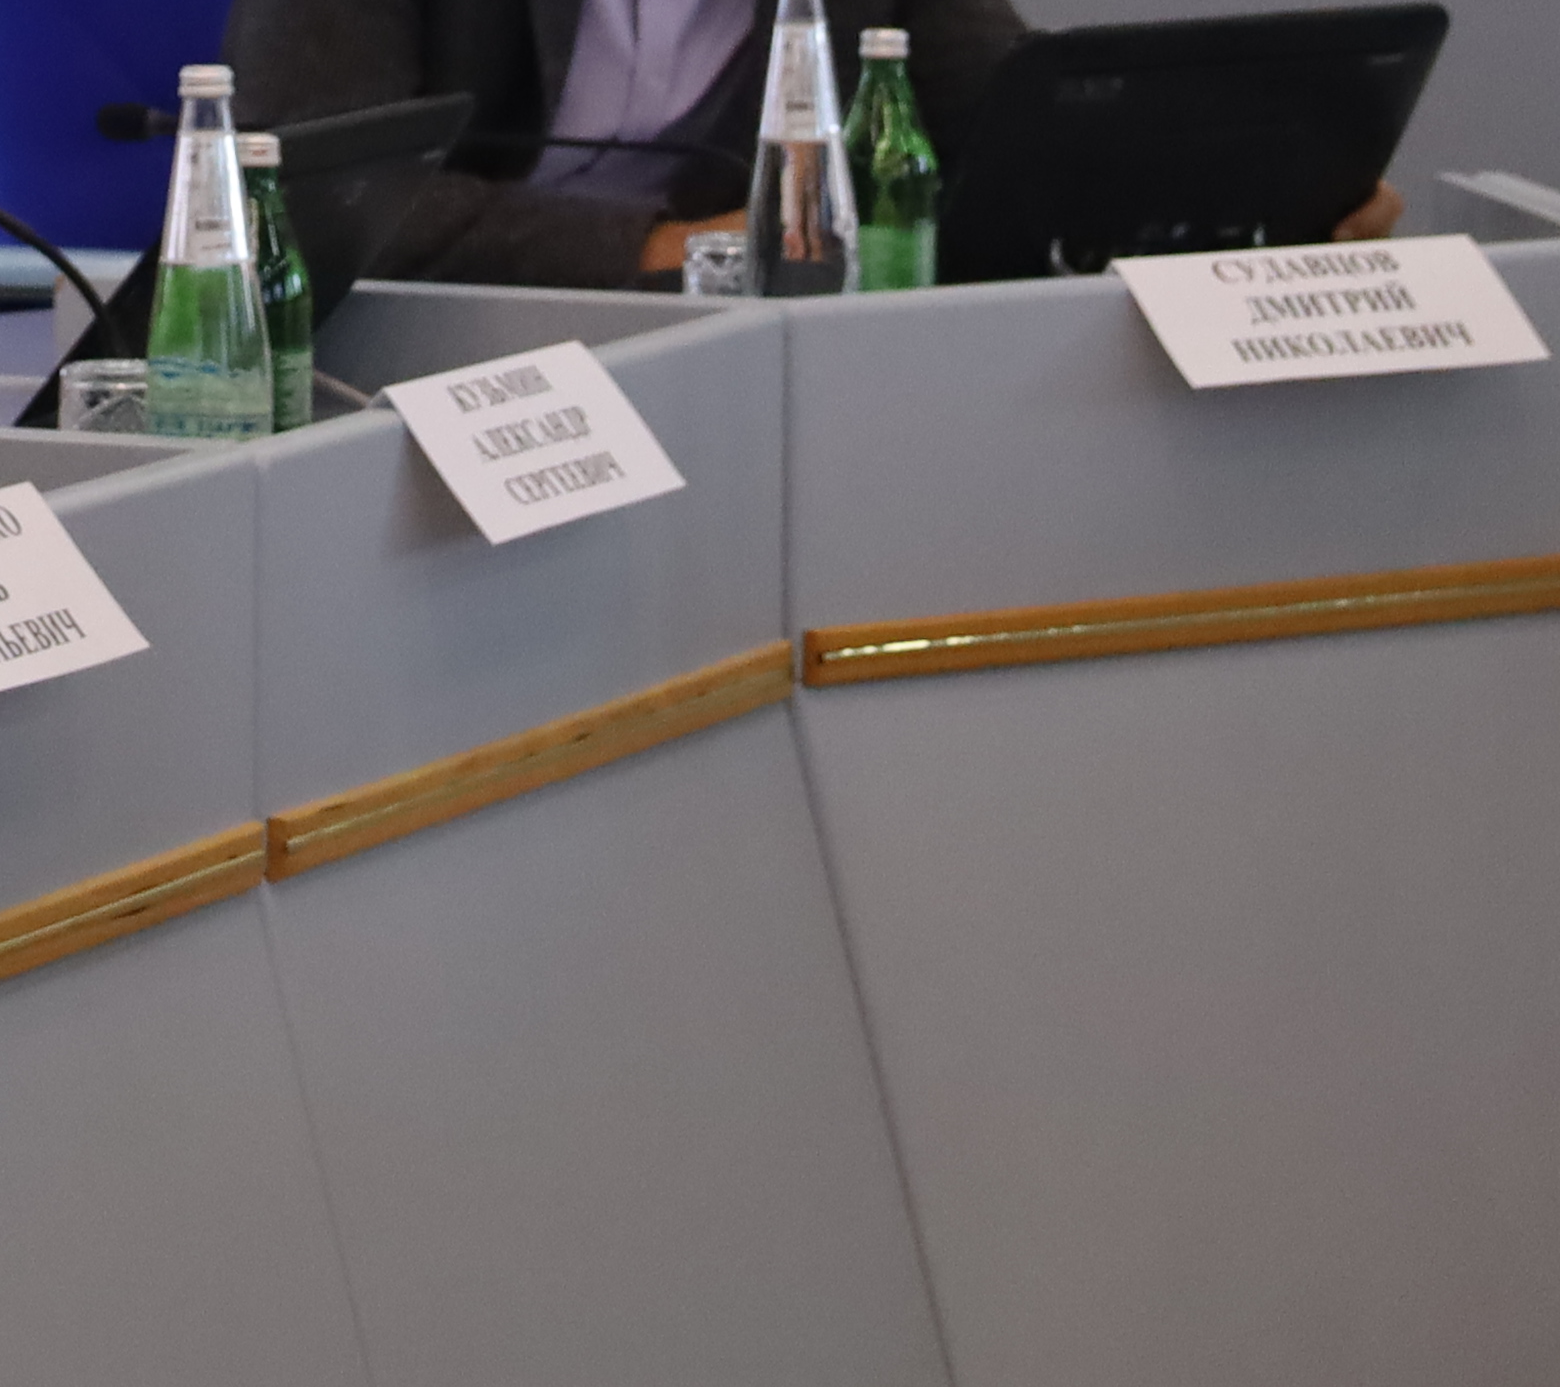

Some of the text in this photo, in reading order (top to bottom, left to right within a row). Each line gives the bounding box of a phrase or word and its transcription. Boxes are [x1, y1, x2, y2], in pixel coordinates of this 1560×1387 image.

[1211, 249, 1400, 284] СУДАВЦОВ
[1245, 280, 1417, 326] ДМИТРИЙ
[1231, 320, 1476, 363] НИКОЛАЕВИЧ
